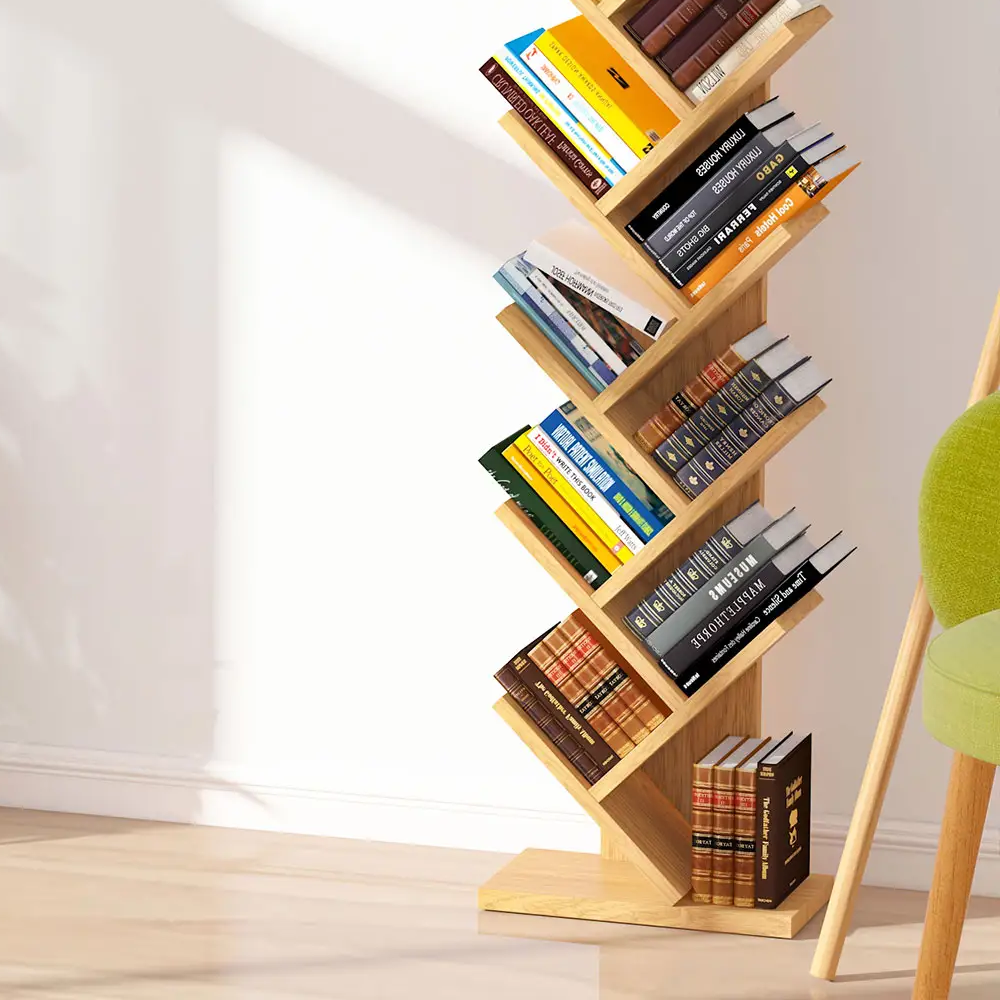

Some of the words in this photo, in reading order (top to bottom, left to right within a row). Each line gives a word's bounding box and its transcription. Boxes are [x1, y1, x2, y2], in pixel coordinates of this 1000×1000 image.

[522, 444, 538, 463] Poet
[543, 467, 559, 485] Poet
[538, 437, 557, 459] Didn't
[556, 456, 572, 474] WRITE
[570, 472, 582, 487] THIS
[580, 484, 597, 501] BOOK
[551, 423, 577, 451] VIRTUAL
[568, 441, 593, 468] PATIENT
[582, 458, 616, 493] SIMULATION
[614, 524, 627, 539] Jeff
[623, 534, 638, 551] Watts
[762, 797, 770, 809] The
[762, 809, 770, 840] Godfather
[762, 840, 770, 862] Family
